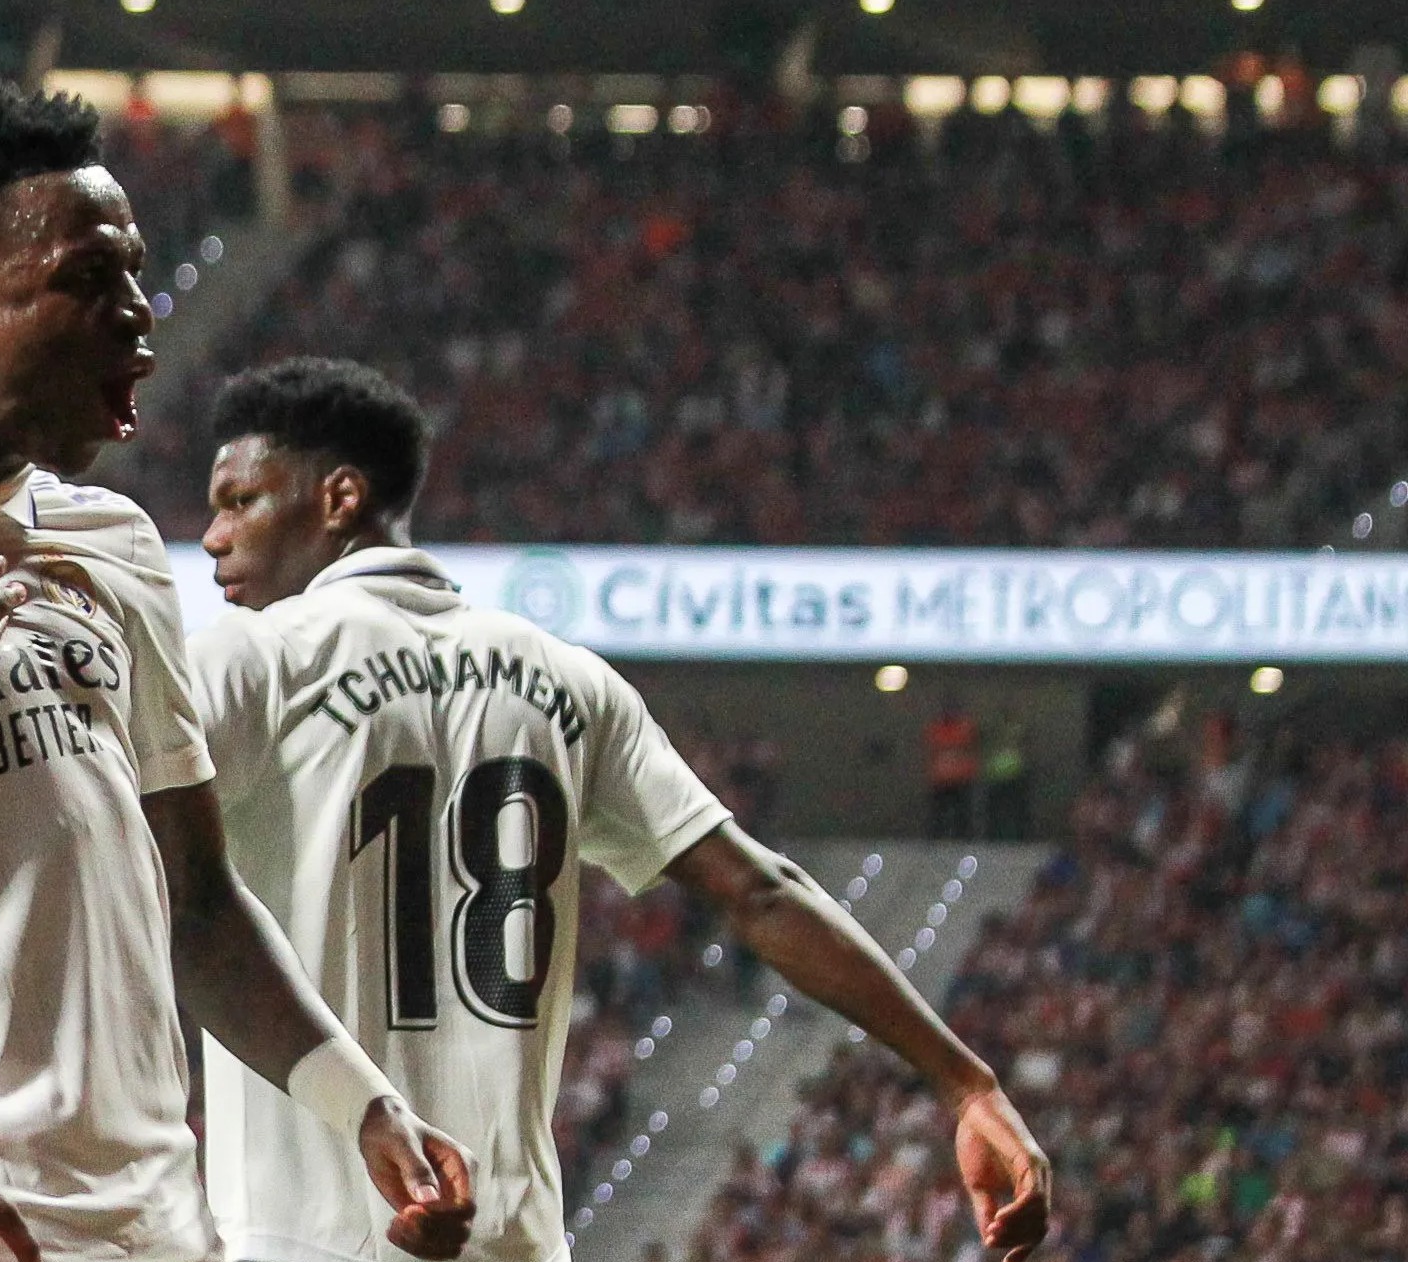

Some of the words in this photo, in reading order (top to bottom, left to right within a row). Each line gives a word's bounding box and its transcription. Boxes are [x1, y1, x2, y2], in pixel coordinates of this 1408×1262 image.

[595, 562, 875, 632] Civitas
[892, 562, 1408, 636] METROPOLITAN
[349, 755, 569, 1031] 18
